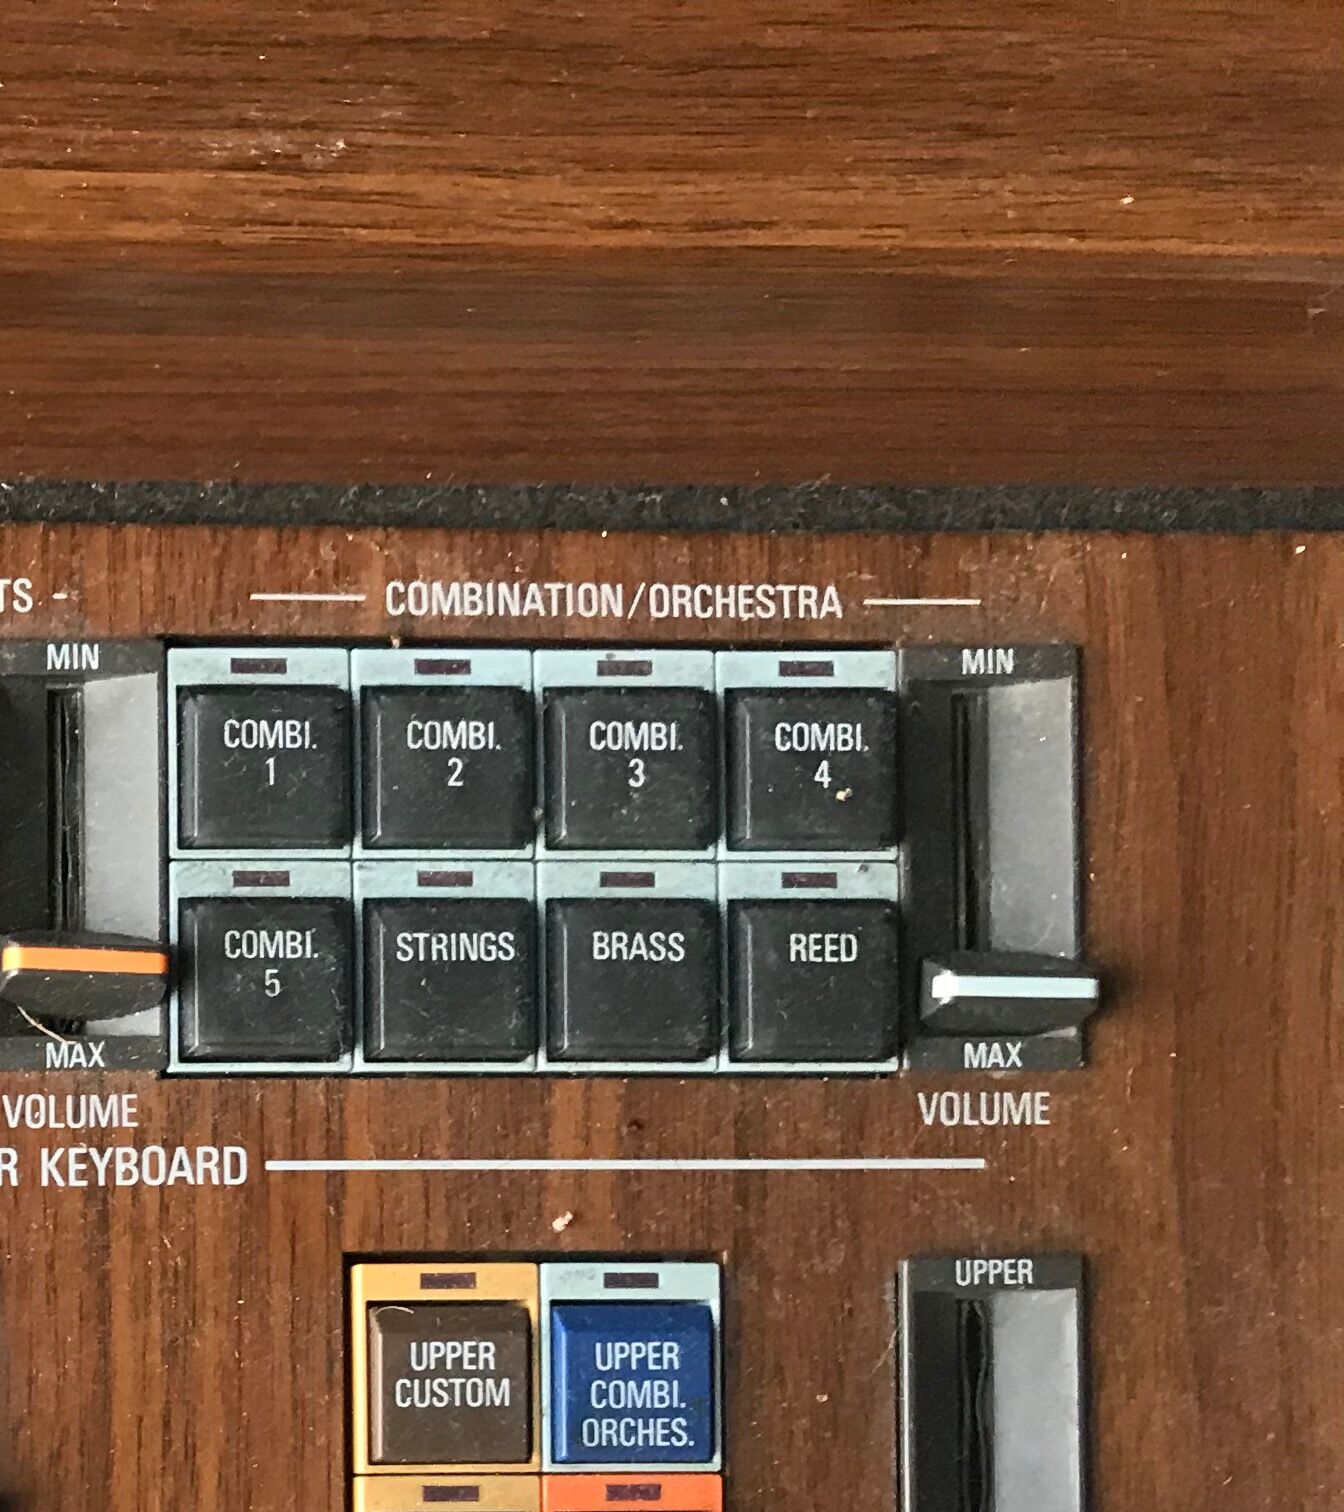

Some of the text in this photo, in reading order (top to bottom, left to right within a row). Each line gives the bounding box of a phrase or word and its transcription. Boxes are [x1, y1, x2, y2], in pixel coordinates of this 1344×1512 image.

[46, 643, 100, 670] MIN
[961, 648, 1015, 675] MIN
[223, 718, 319, 749] COMBI.
[406, 719, 501, 750] COMBI.
[589, 720, 683, 751] COMBI.
[774, 721, 869, 752] COMBI.
[265, 757, 275, 786] 1
[447, 757, 464, 787] 2
[628, 757, 646, 788] 3
[813, 759, 832, 789] 4
[224, 929, 319, 959] COMBI.
[396, 931, 516, 962] STRINGS
[592, 930, 685, 962] BRASS
[789, 932, 858, 963] REED
[264, 968, 281, 998] 5
[45, 1041, 106, 1069] MAX
[964, 1041, 1023, 1069] MAX
[2, 1093, 139, 1129] VOLUME
[917, 1091, 1051, 1127] VOLUME
[40, 1146, 248, 1187] KEYBOARD
[955, 1258, 1034, 1287] UPPER
[410, 1340, 496, 1372] UPPER
[595, 1341, 680, 1372] UPPER
[395, 1377, 511, 1408] CUSTOM
[590, 1379, 687, 1409] COMBI.
[582, 1417, 695, 1447] ORCHES.
